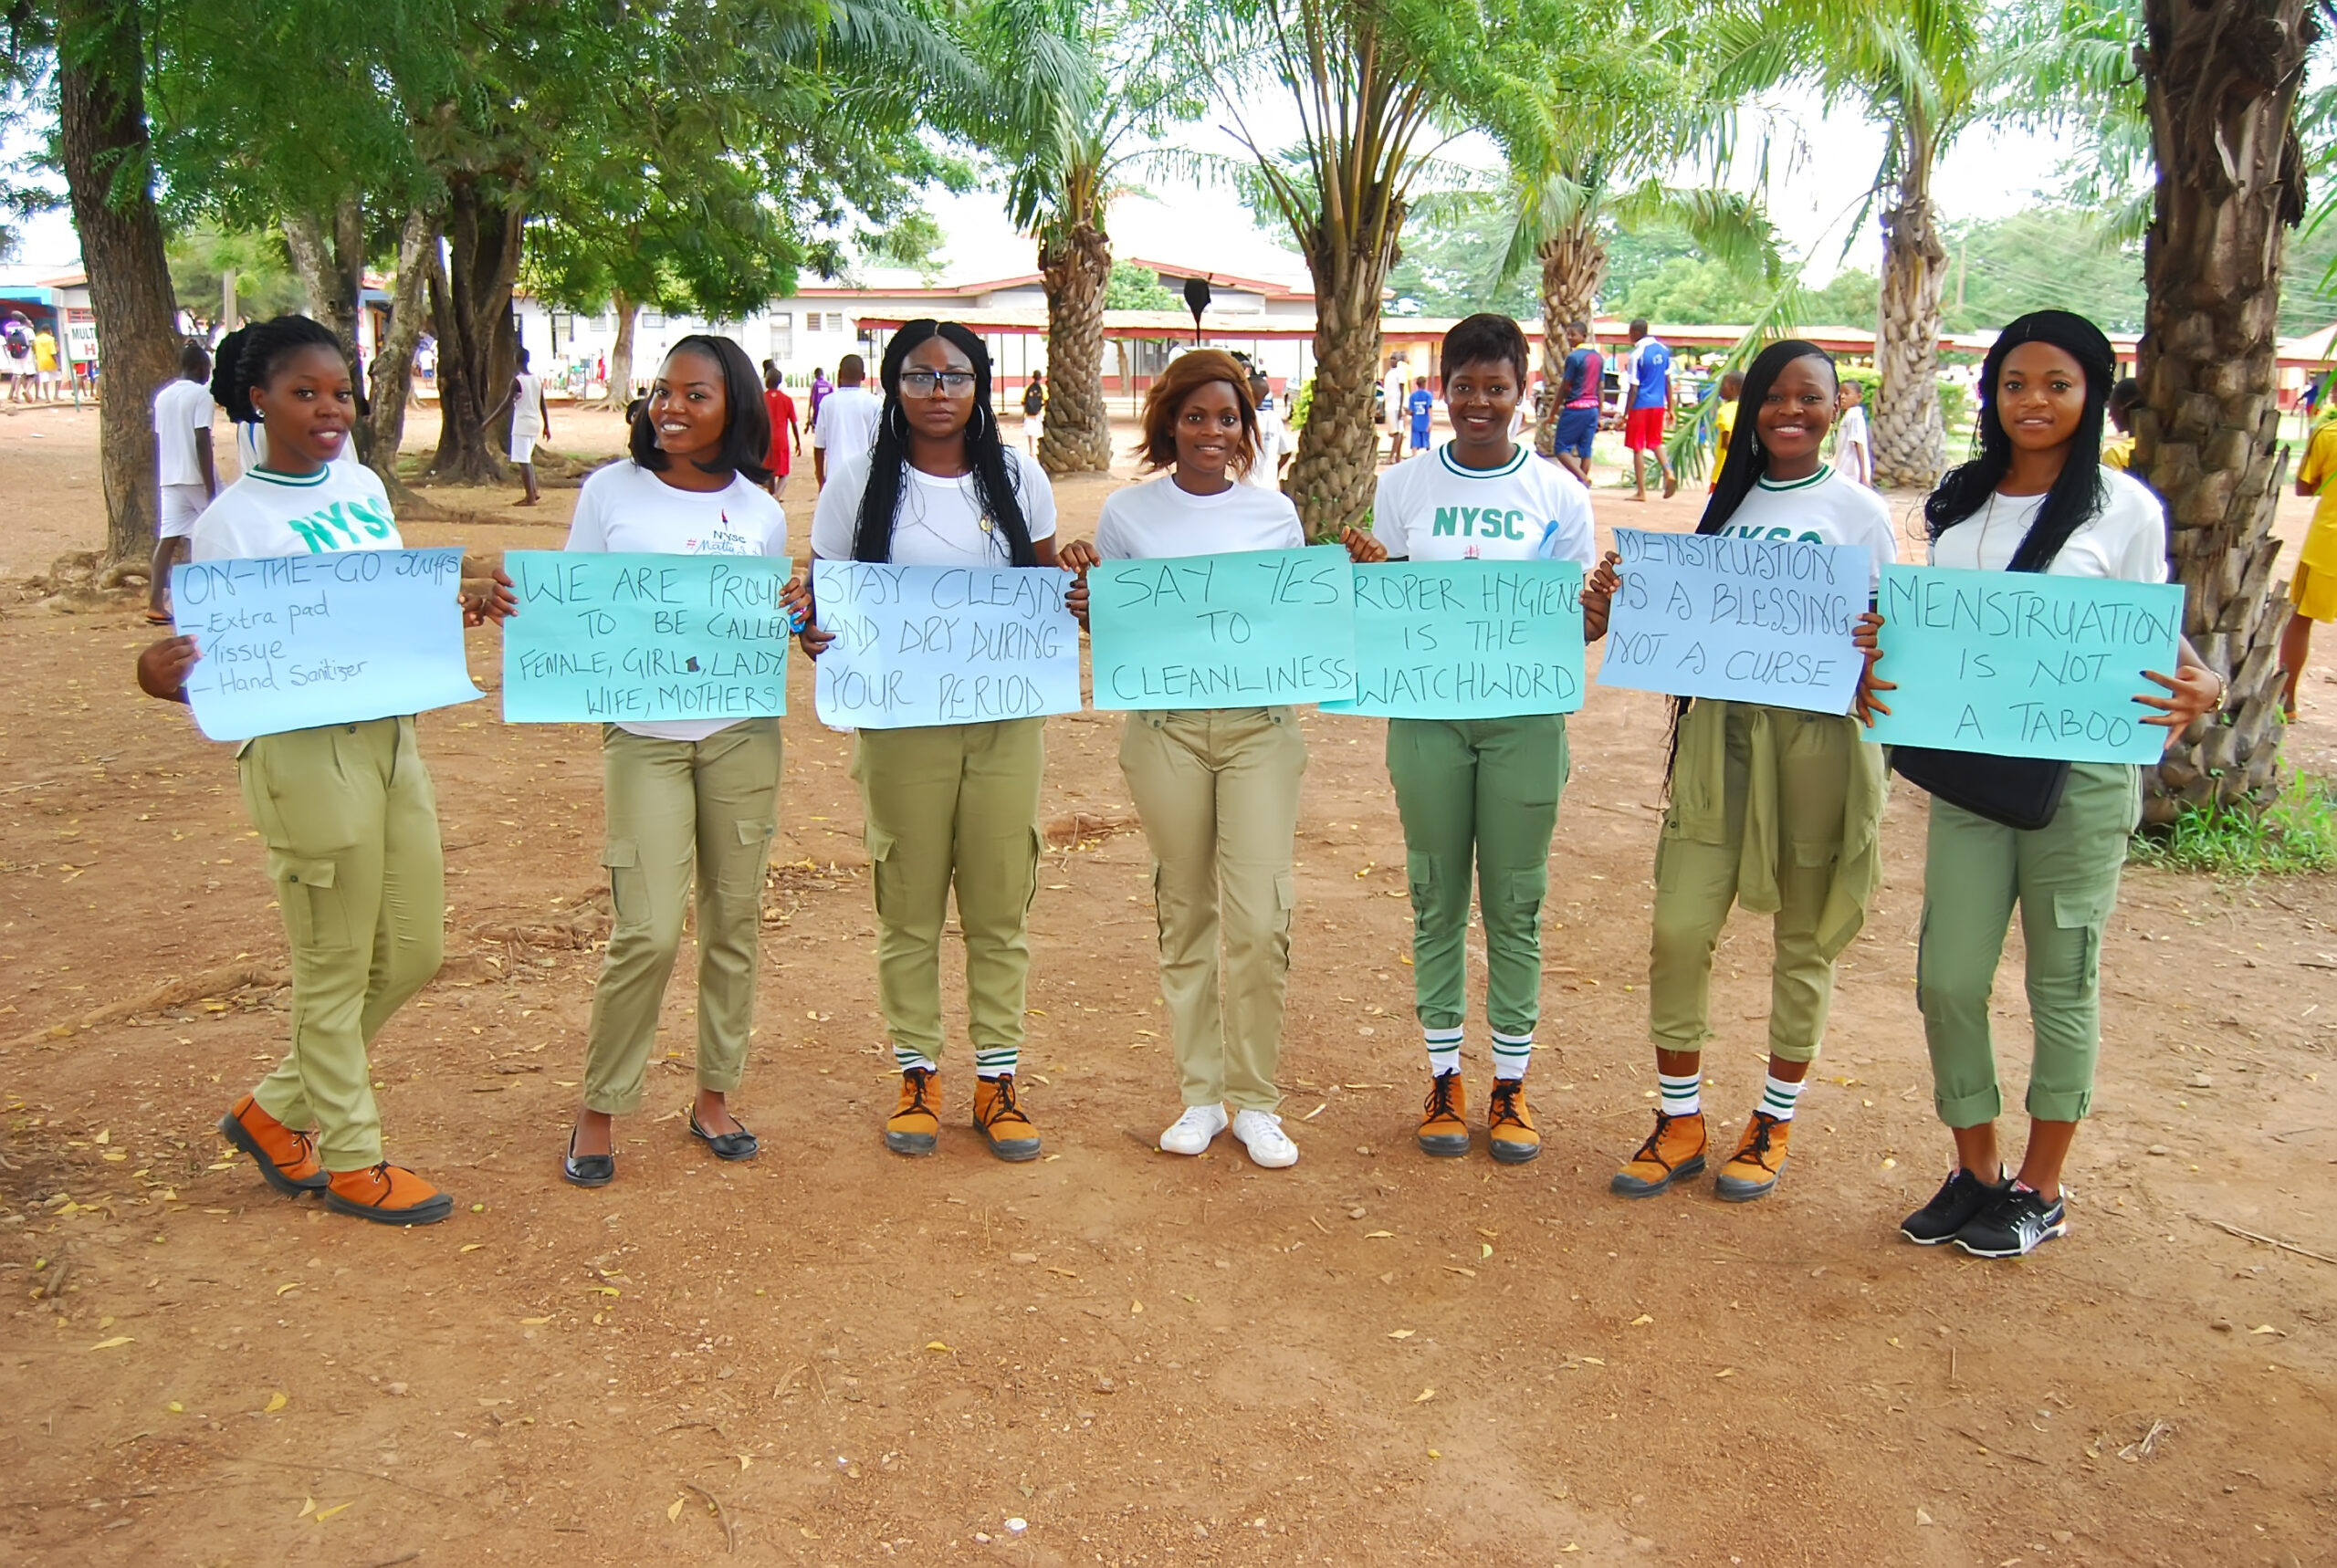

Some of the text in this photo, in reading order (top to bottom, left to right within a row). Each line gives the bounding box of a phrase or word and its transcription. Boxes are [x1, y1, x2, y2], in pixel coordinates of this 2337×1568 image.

[71, 327, 95, 340] MULT
[713, 529, 747, 544] NYSC
[1431, 507, 1525, 541] NYSC
[183, 553, 381, 604] ON-THE-GO
[1616, 530, 1836, 586] MENSTRUATION
[522, 561, 592, 605] WE
[613, 567, 684, 603] ARE
[815, 564, 1063, 620] STAY CLEAN
[1115, 557, 1339, 609] SAY YES
[1354, 571, 1582, 617] ROPER HYGIENE
[1617, 572, 1850, 637] IS A BLESSING
[288, 590, 330, 635] pad
[578, 609, 789, 640] TO BE CALLED
[1196, 610, 1251, 643] TO
[1889, 575, 2176, 650] MENSTRUATION
[823, 612, 1064, 663] AND DRY DURING
[1404, 619, 1529, 652] IS THE
[219, 660, 280, 695] Hand
[519, 649, 612, 679] FEMALE,
[1112, 655, 1353, 700] CLEANLINESS
[1607, 631, 1837, 686] NOT A CURSE
[1959, 648, 2112, 688] IS NOT
[586, 681, 777, 718] WIFE, MOTHERS
[825, 664, 1044, 721] YOUR PERIOD
[1356, 662, 1576, 707] WATCHWORD
[1954, 702, 2132, 747] A TABOO
